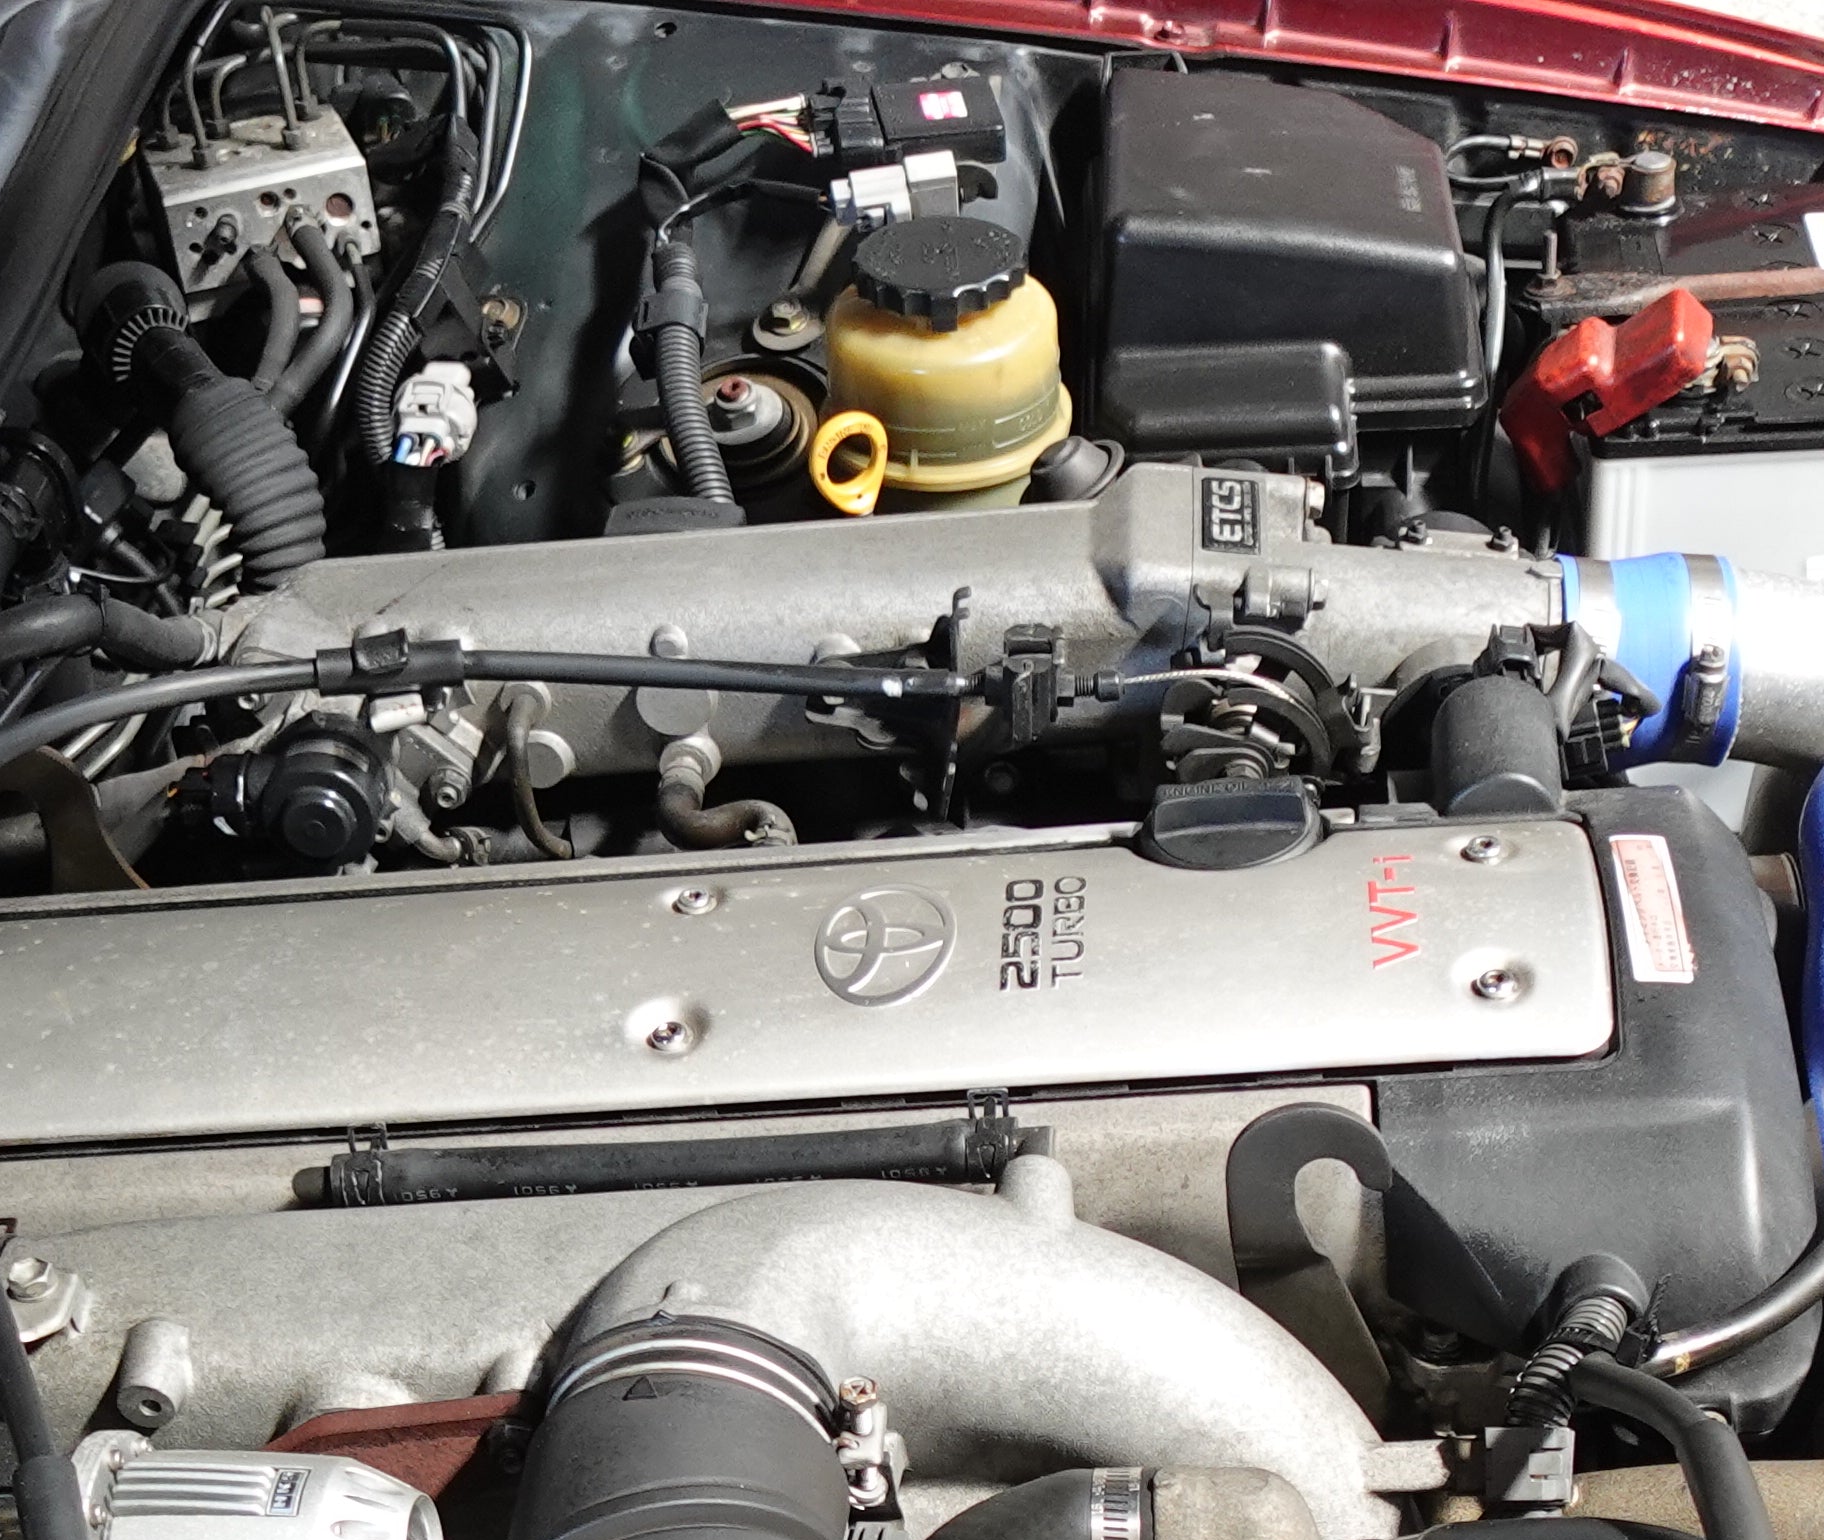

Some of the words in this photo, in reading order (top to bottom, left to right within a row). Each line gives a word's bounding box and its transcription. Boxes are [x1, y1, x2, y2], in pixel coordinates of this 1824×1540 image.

[1211, 480, 1243, 542] ETCS
[1000, 879, 1043, 990] 2500
[1051, 876, 1086, 987] TURBO
[1368, 855, 1419, 968] VVT-i
